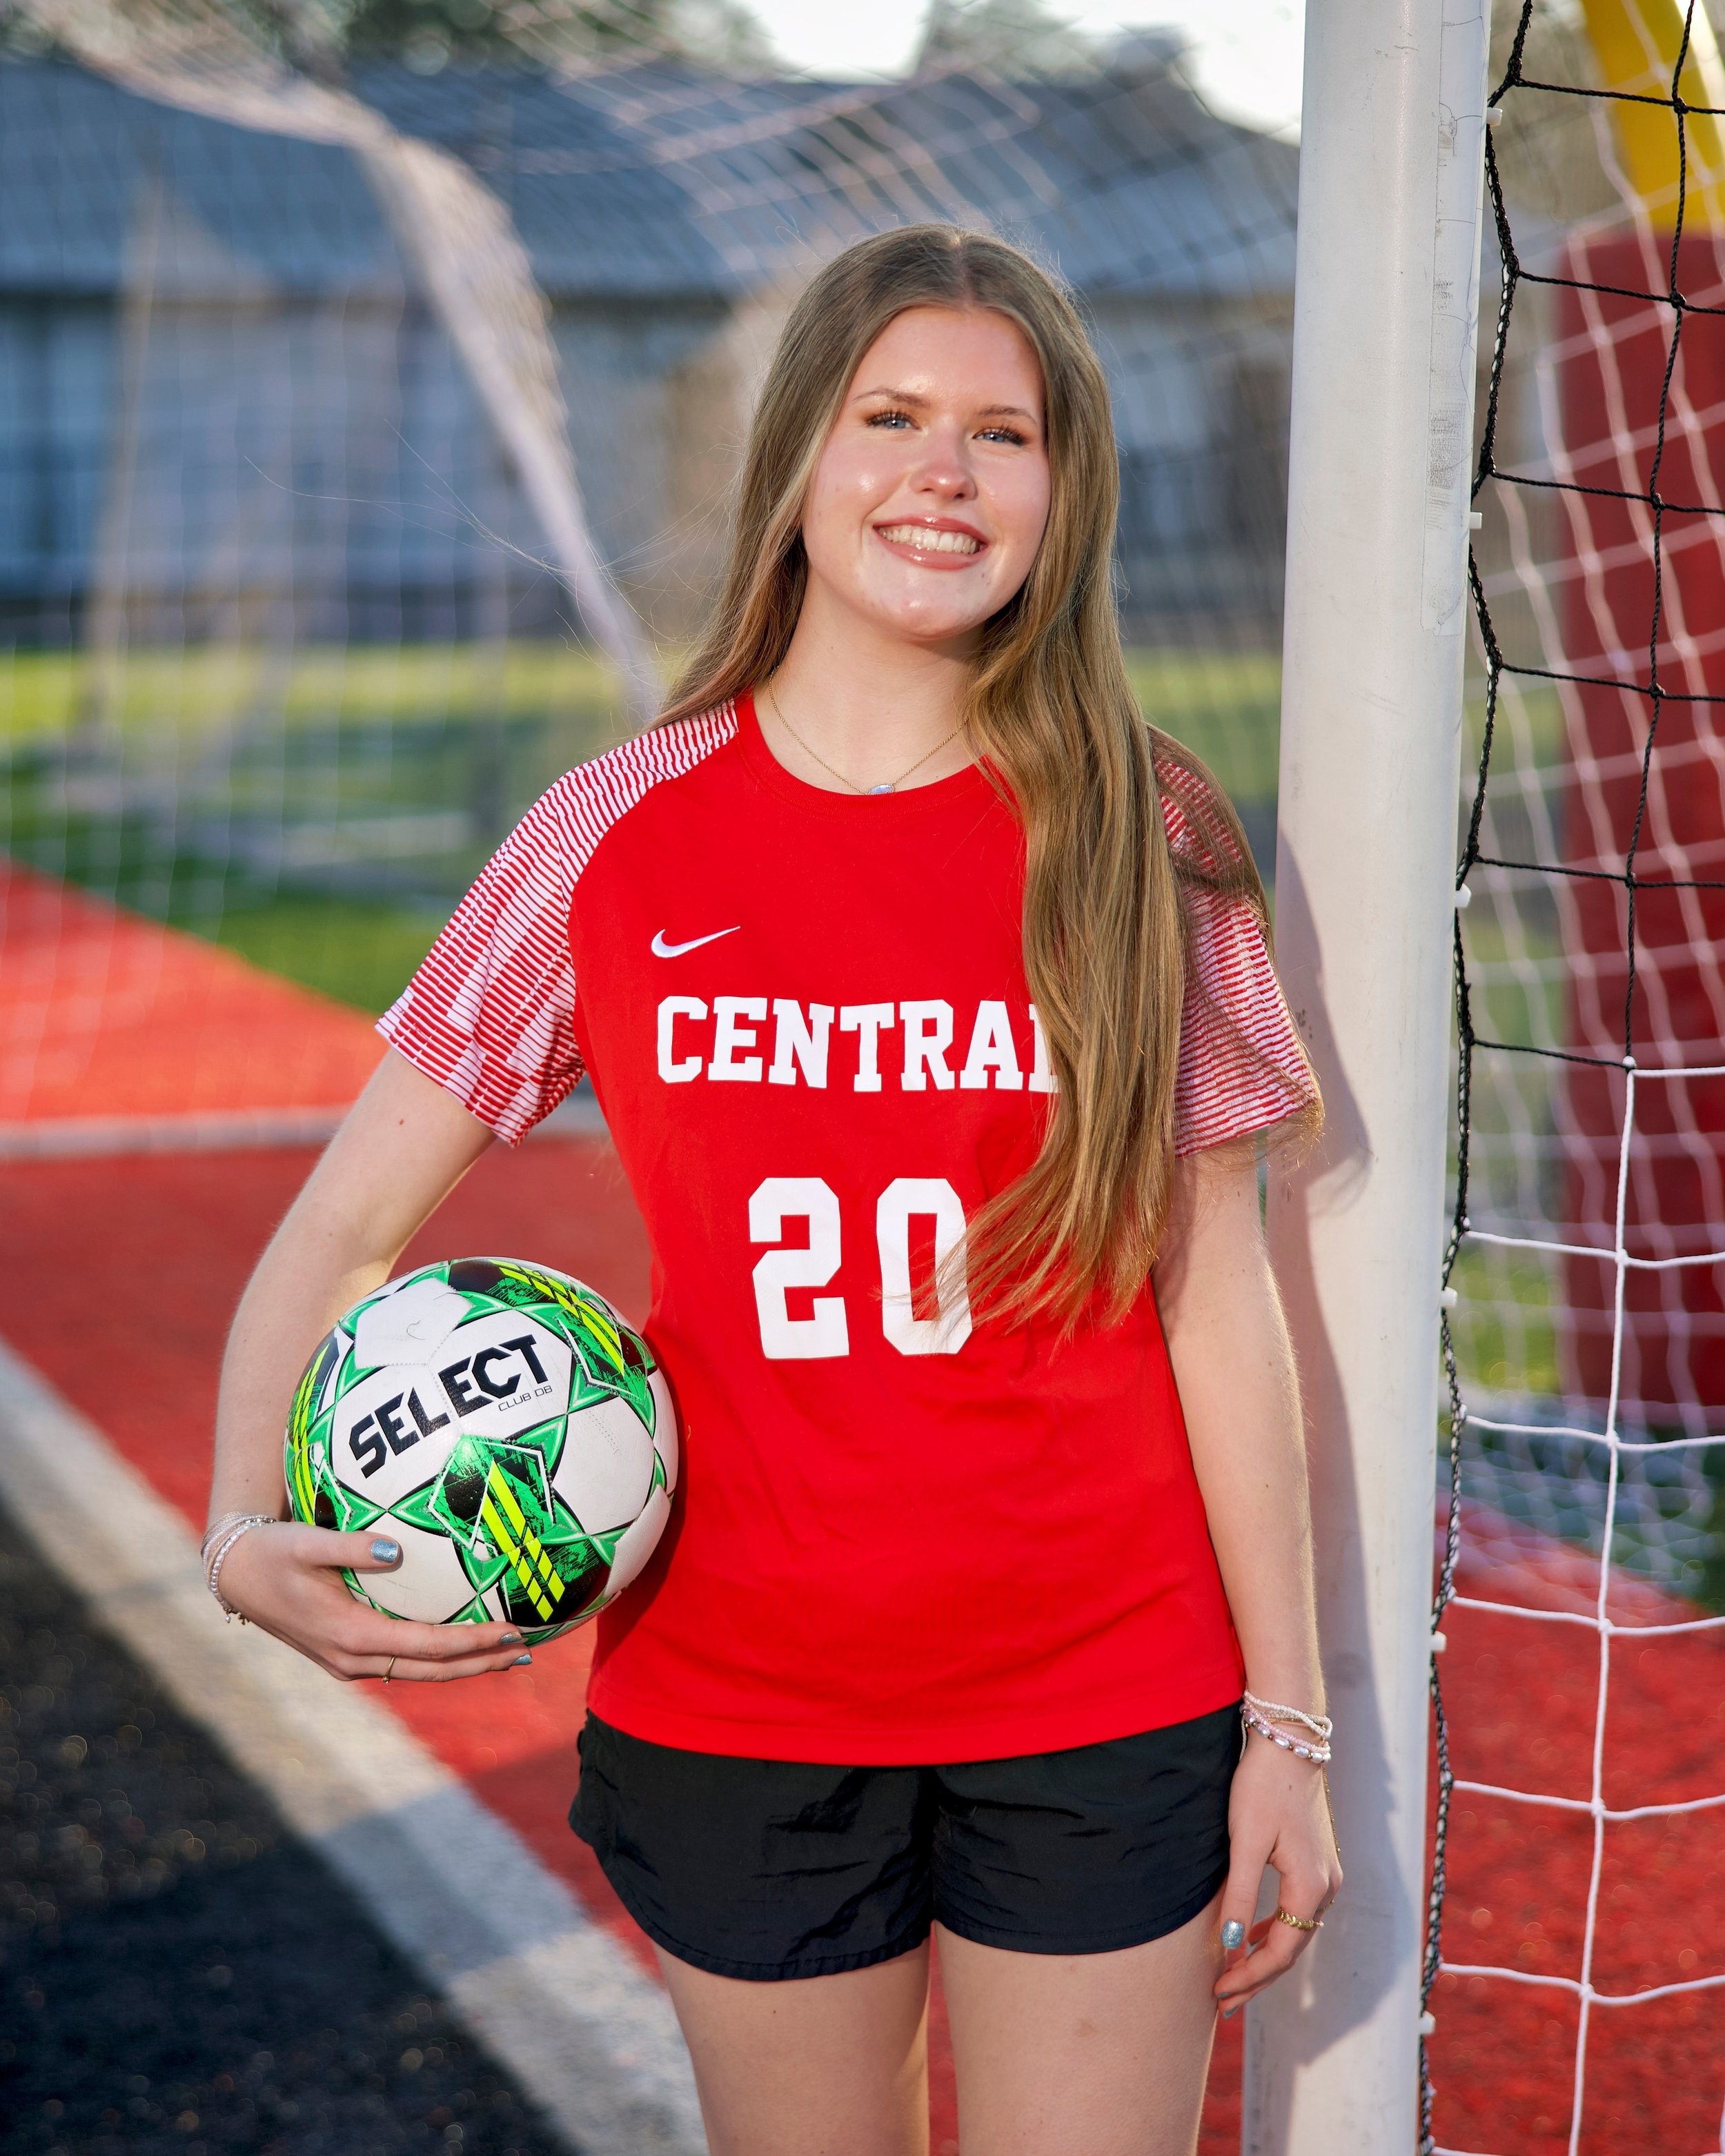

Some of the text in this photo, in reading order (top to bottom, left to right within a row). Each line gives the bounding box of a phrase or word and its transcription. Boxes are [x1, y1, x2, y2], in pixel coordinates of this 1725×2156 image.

[748, 1177, 973, 1360] 20
[348, 1334, 549, 1479] SELECT
[497, 1384, 553, 1412] CLUB DB
